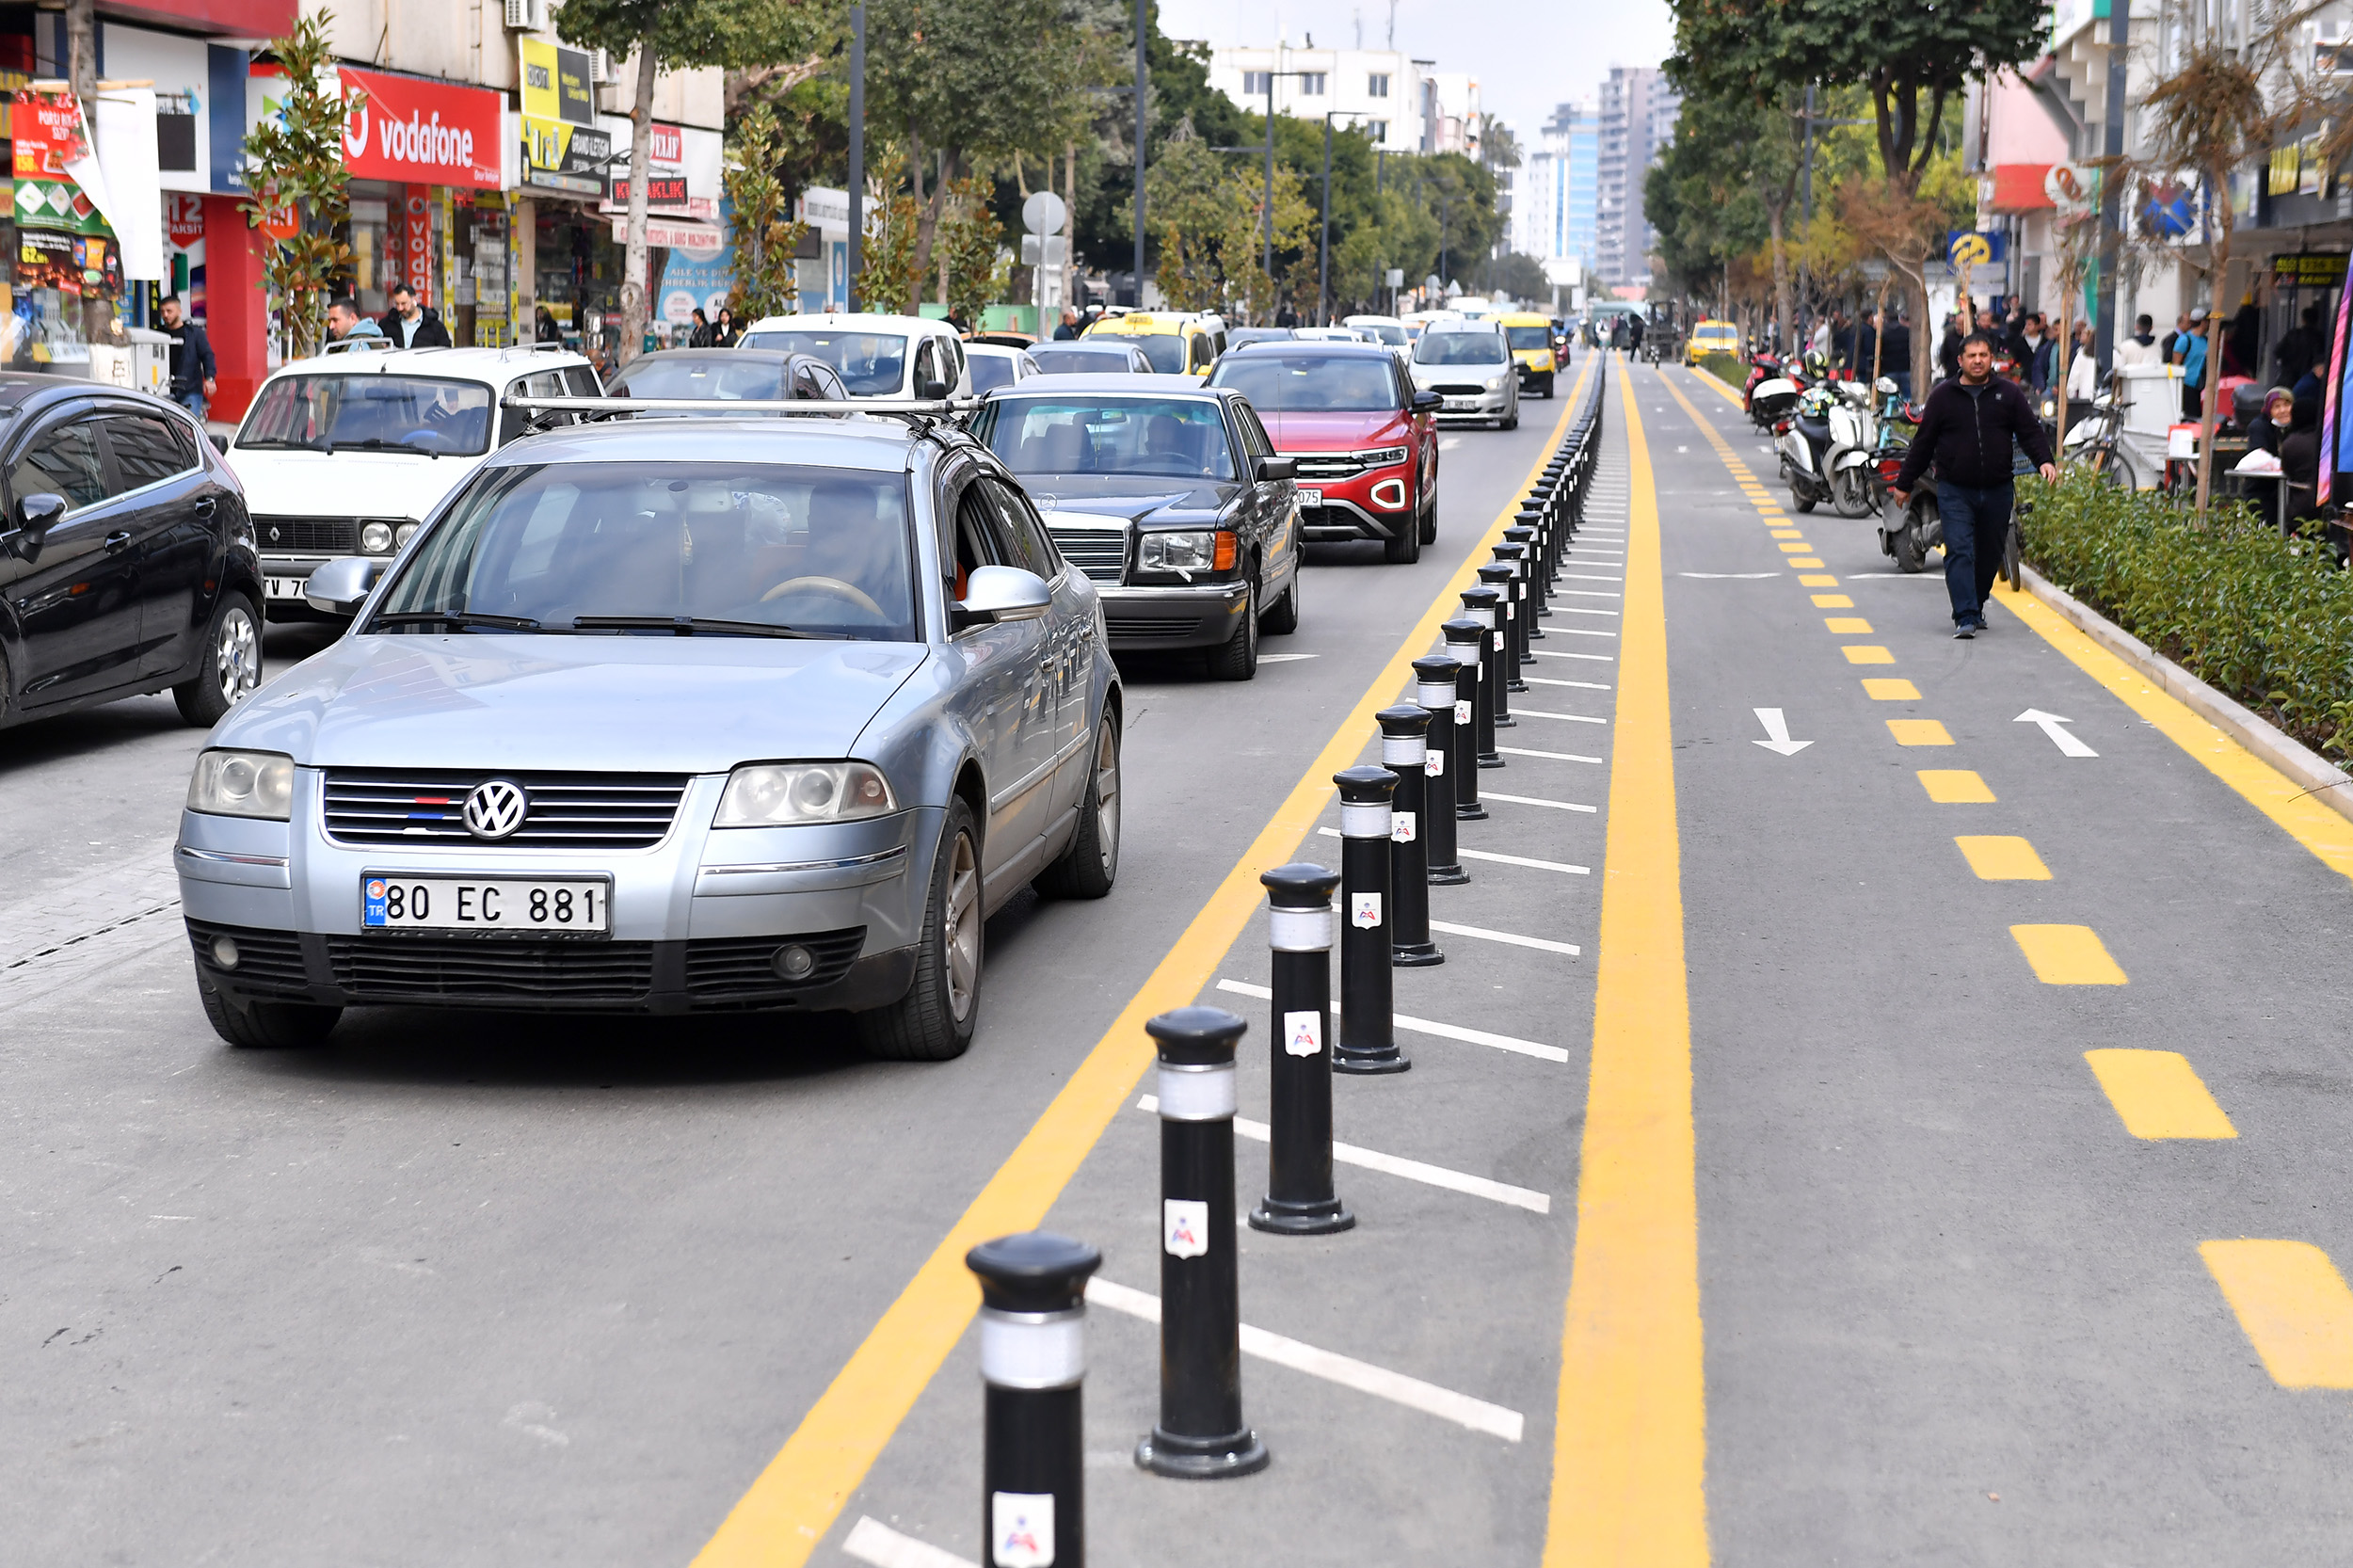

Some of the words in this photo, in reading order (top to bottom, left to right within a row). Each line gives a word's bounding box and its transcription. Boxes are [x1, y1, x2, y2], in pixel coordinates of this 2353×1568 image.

[379, 108, 473, 168] vodafone
[616, 182, 683, 200] KAKLIK
[170, 222, 203, 235] AKSİT
[1299, 491, 1319, 504] 075
[368, 904, 384, 917] TR
[387, 885, 429, 920] 80
[457, 887, 502, 921] EC
[529, 888, 595, 923] 881
